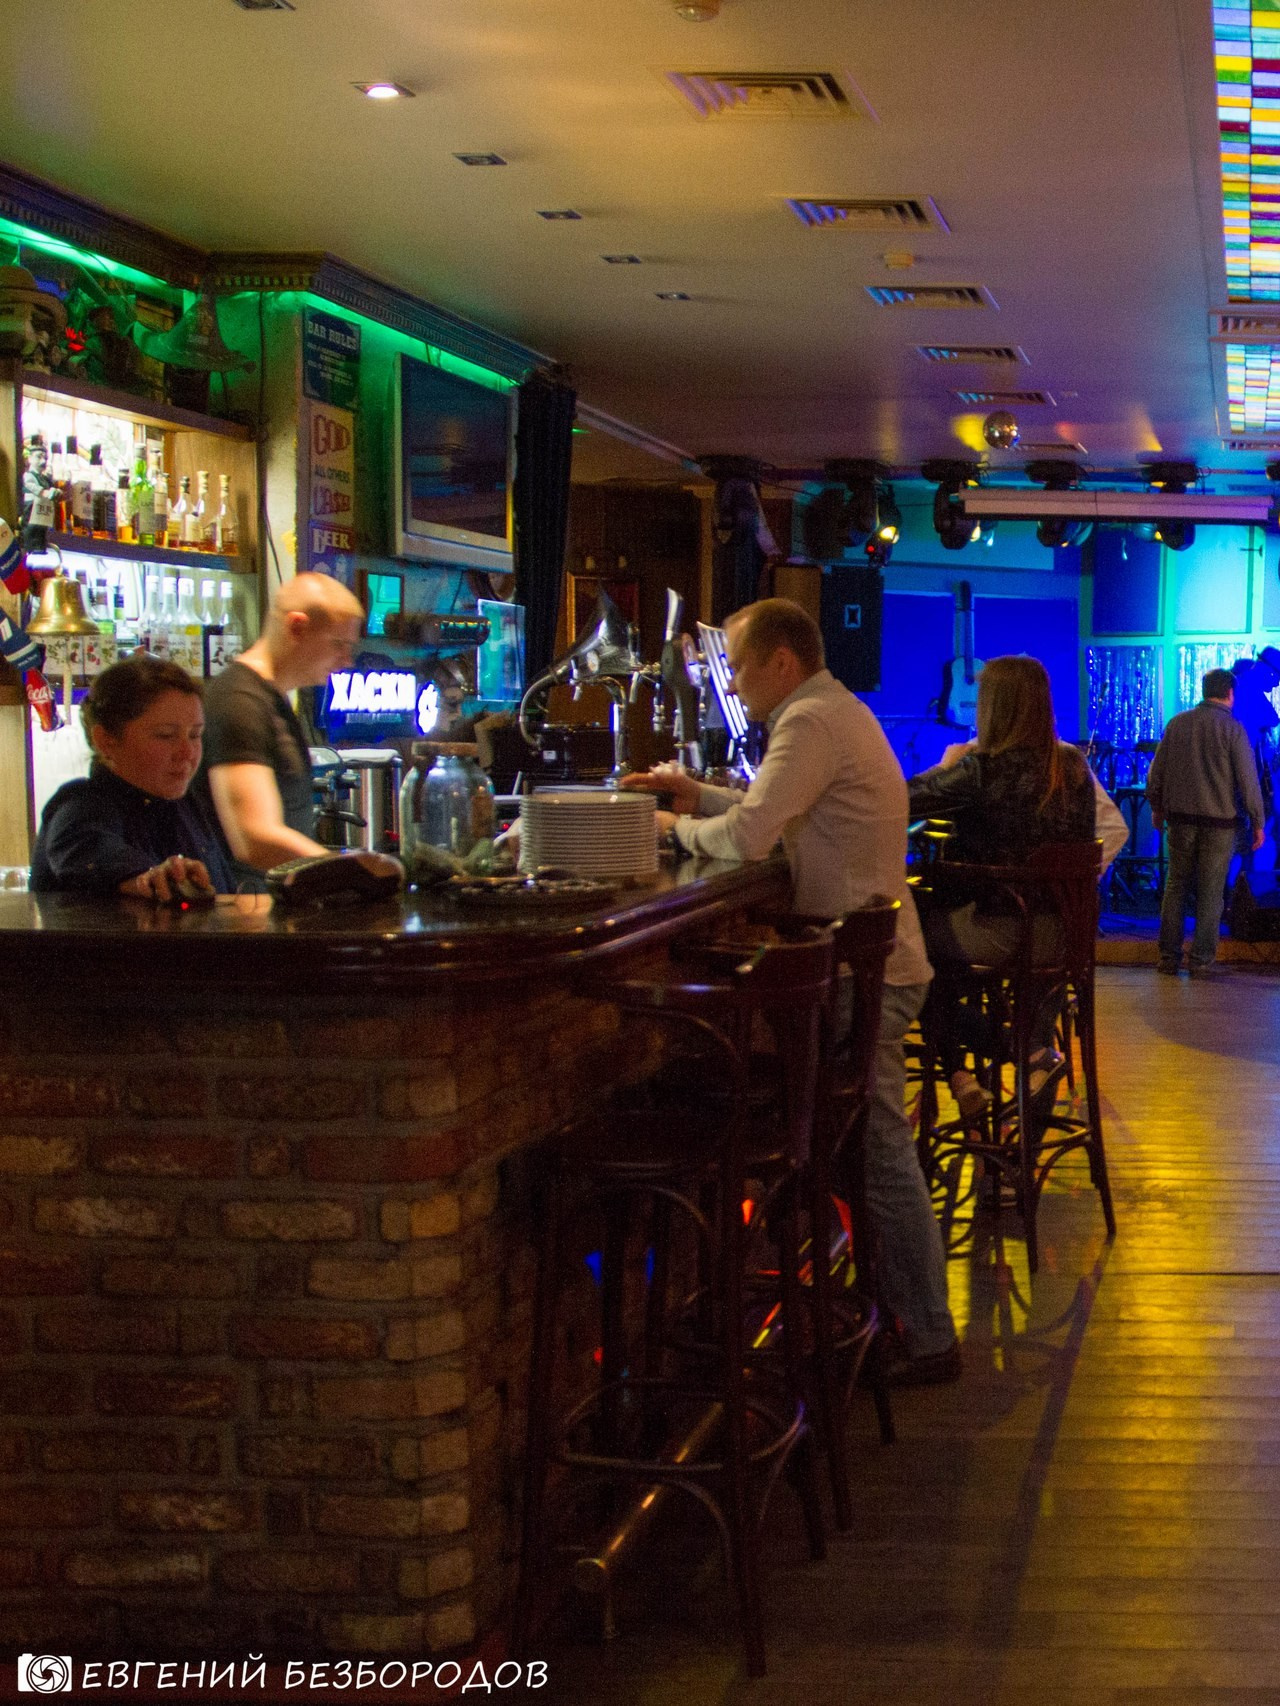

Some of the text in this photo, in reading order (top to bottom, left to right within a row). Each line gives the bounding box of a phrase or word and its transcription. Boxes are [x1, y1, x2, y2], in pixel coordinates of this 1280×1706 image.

[307, 321, 357, 350] BAR RULES
[313, 414, 350, 455] GOD
[312, 528, 350, 553] BEER
